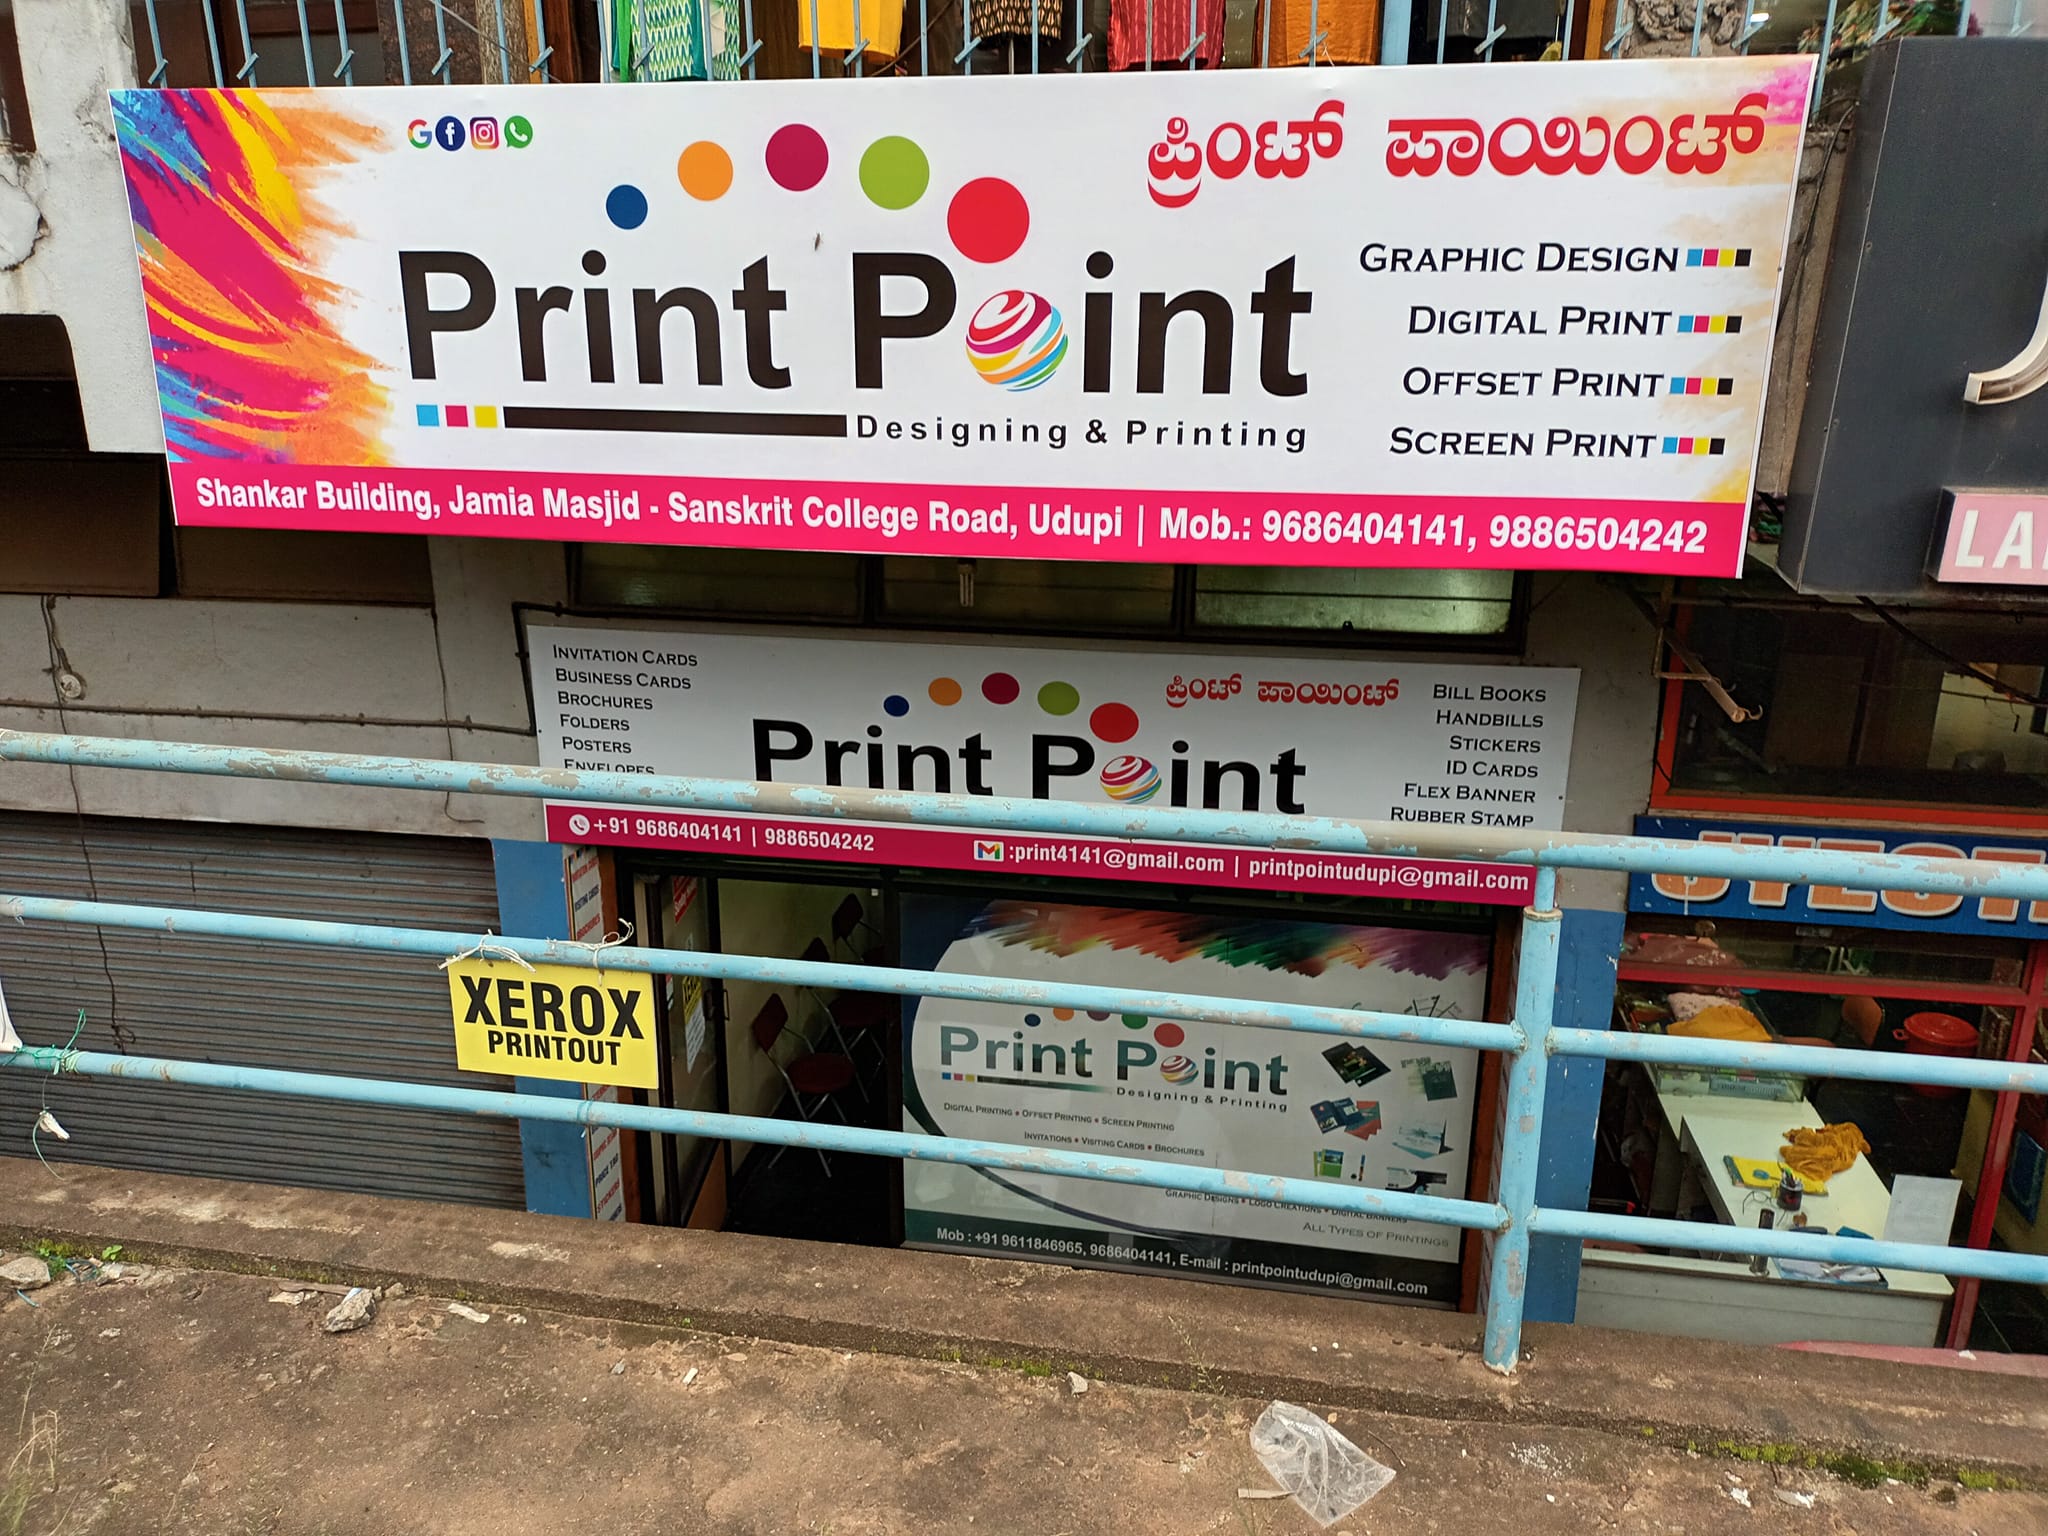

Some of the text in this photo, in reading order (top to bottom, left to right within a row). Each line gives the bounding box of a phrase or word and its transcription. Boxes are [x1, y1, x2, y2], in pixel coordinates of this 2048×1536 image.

[1360, 243, 1678, 272] GRAPHIC DESIGN
[399, 249, 791, 389] Print
[1408, 306, 1672, 336] DIGITAL PRINT
[1403, 367, 1664, 397] OFFSET PRINT
[857, 414, 1307, 453] Designing & Printing
[1390, 427, 1657, 458] SCREEN PRINT
[196, 478, 307, 509] Shankar
[315, 481, 441, 521] Building,
[448, 484, 534, 517] Jamia
[543, 487, 641, 527] Masjid
[668, 491, 793, 526] Sanskrit
[802, 496, 918, 538] College
[929, 500, 1018, 539] Road,
[1028, 503, 1122, 544] Udupi
[1158, 506, 1251, 542] Mob.:
[1263, 509, 1478, 553] 9686404141,
[1489, 514, 1709, 554] 9886504242
[553, 644, 698, 666] INVITATION CARDS
[556, 668, 691, 689] BUSINESS CARDS
[1433, 684, 1546, 702] BILL BOOKS
[558, 691, 653, 710] BROCHURES
[560, 713, 630, 731] FOLDERS
[1436, 710, 1544, 728] HANDBILLS
[562, 736, 632, 754] POSTERS
[752, 718, 994, 797] Print
[1450, 735, 1541, 753] STICKERS
[1446, 760, 1539, 778] ID CARDS
[1404, 783, 1536, 803] FLEX BANNER
[1391, 806, 1534, 827] RUBBER STAMP
[594, 818, 629, 835] +91
[636, 819, 742, 842] 9686404141
[764, 828, 875, 852] 9886504242
[1249, 858, 1529, 891] printpointudupi@gmail.com
[460, 975, 645, 1040] XEROX
[487, 1029, 621, 1066] PRINTOUT
[940, 1024, 1093, 1078] Print
[1116, 1086, 1289, 1113] Designing & Printing
[937, 1227, 965, 1242] Mob
[975, 1232, 998, 1245] +91
[1001, 1234, 1087, 1257] 9611846965,
[1090, 1243, 1177, 1268] 9686404141,
[1180, 1254, 1221, 1271] E-mail
[1231, 1261, 1429, 1296] printpointudupi@gmail.com
